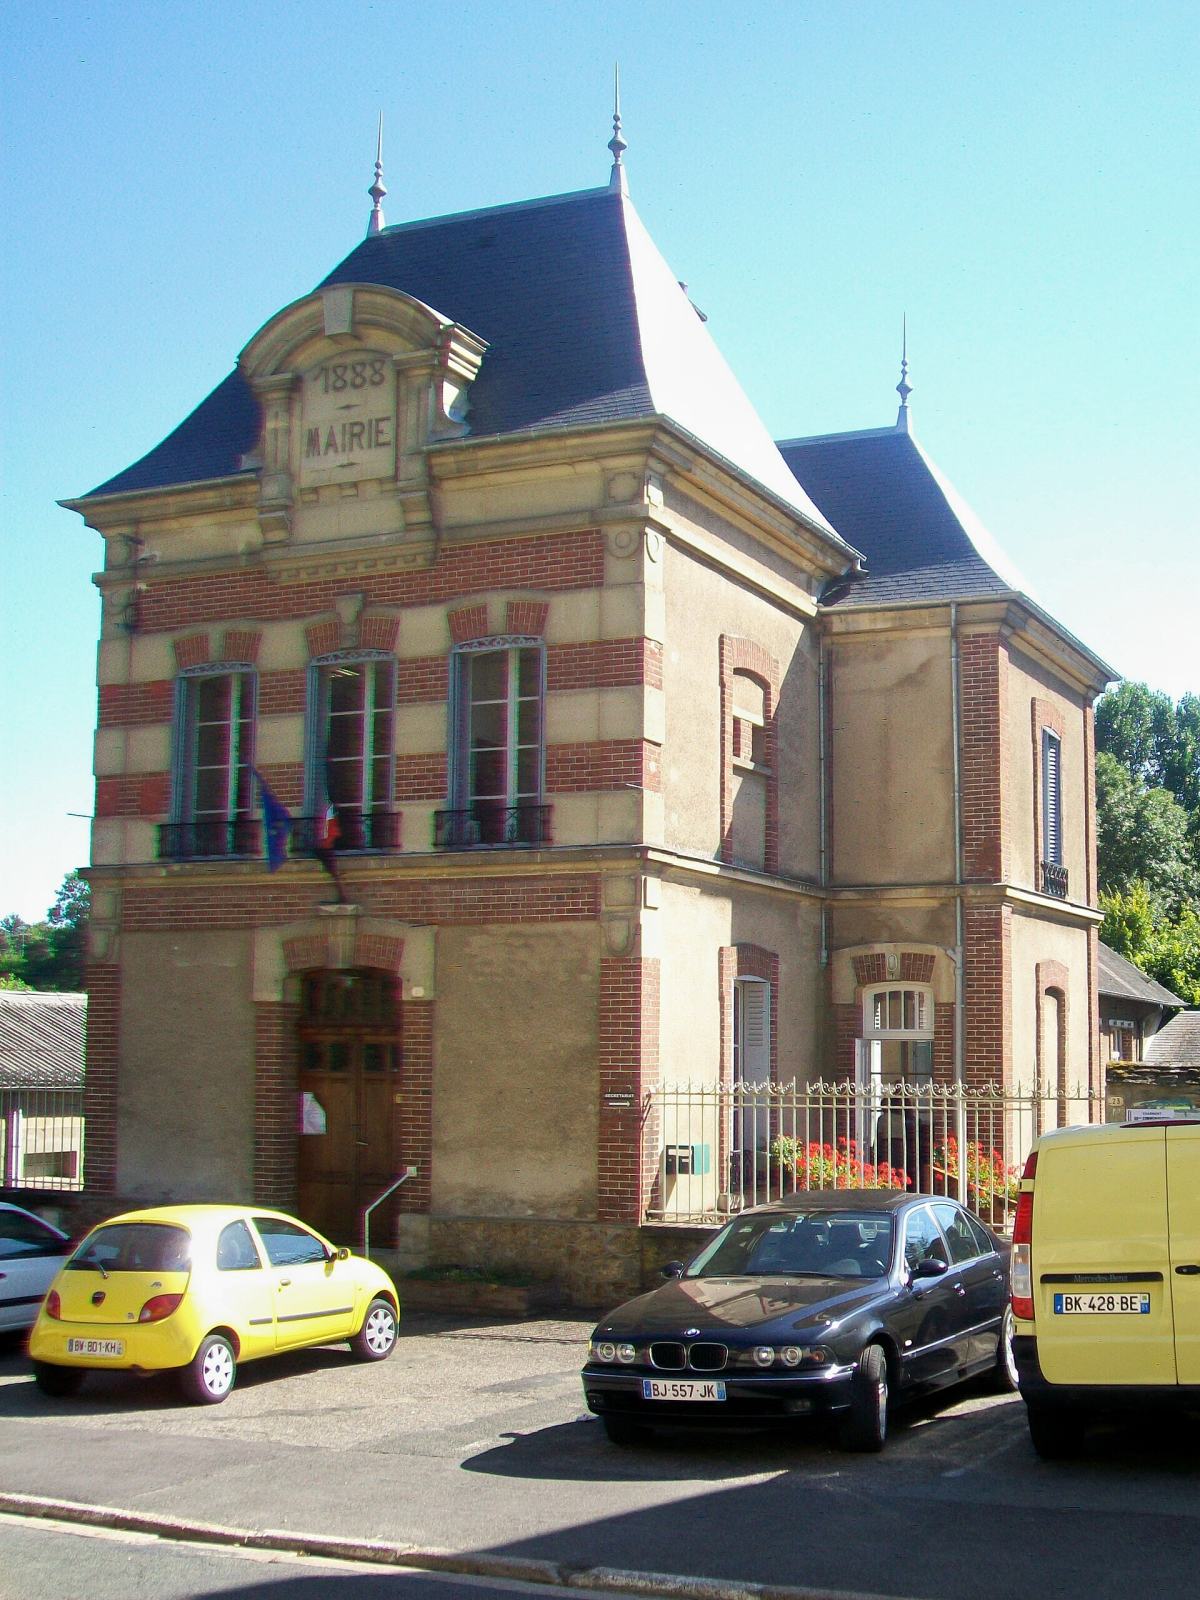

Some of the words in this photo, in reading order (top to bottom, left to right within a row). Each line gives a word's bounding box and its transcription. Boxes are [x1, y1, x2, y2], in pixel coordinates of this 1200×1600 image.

[313, 359, 386, 393] 1888
[305, 416, 392, 458] MAIRIE
[1064, 1296, 1139, 1312] BK-428-BE
[652, 1384, 716, 1398] BJ-557-JK
